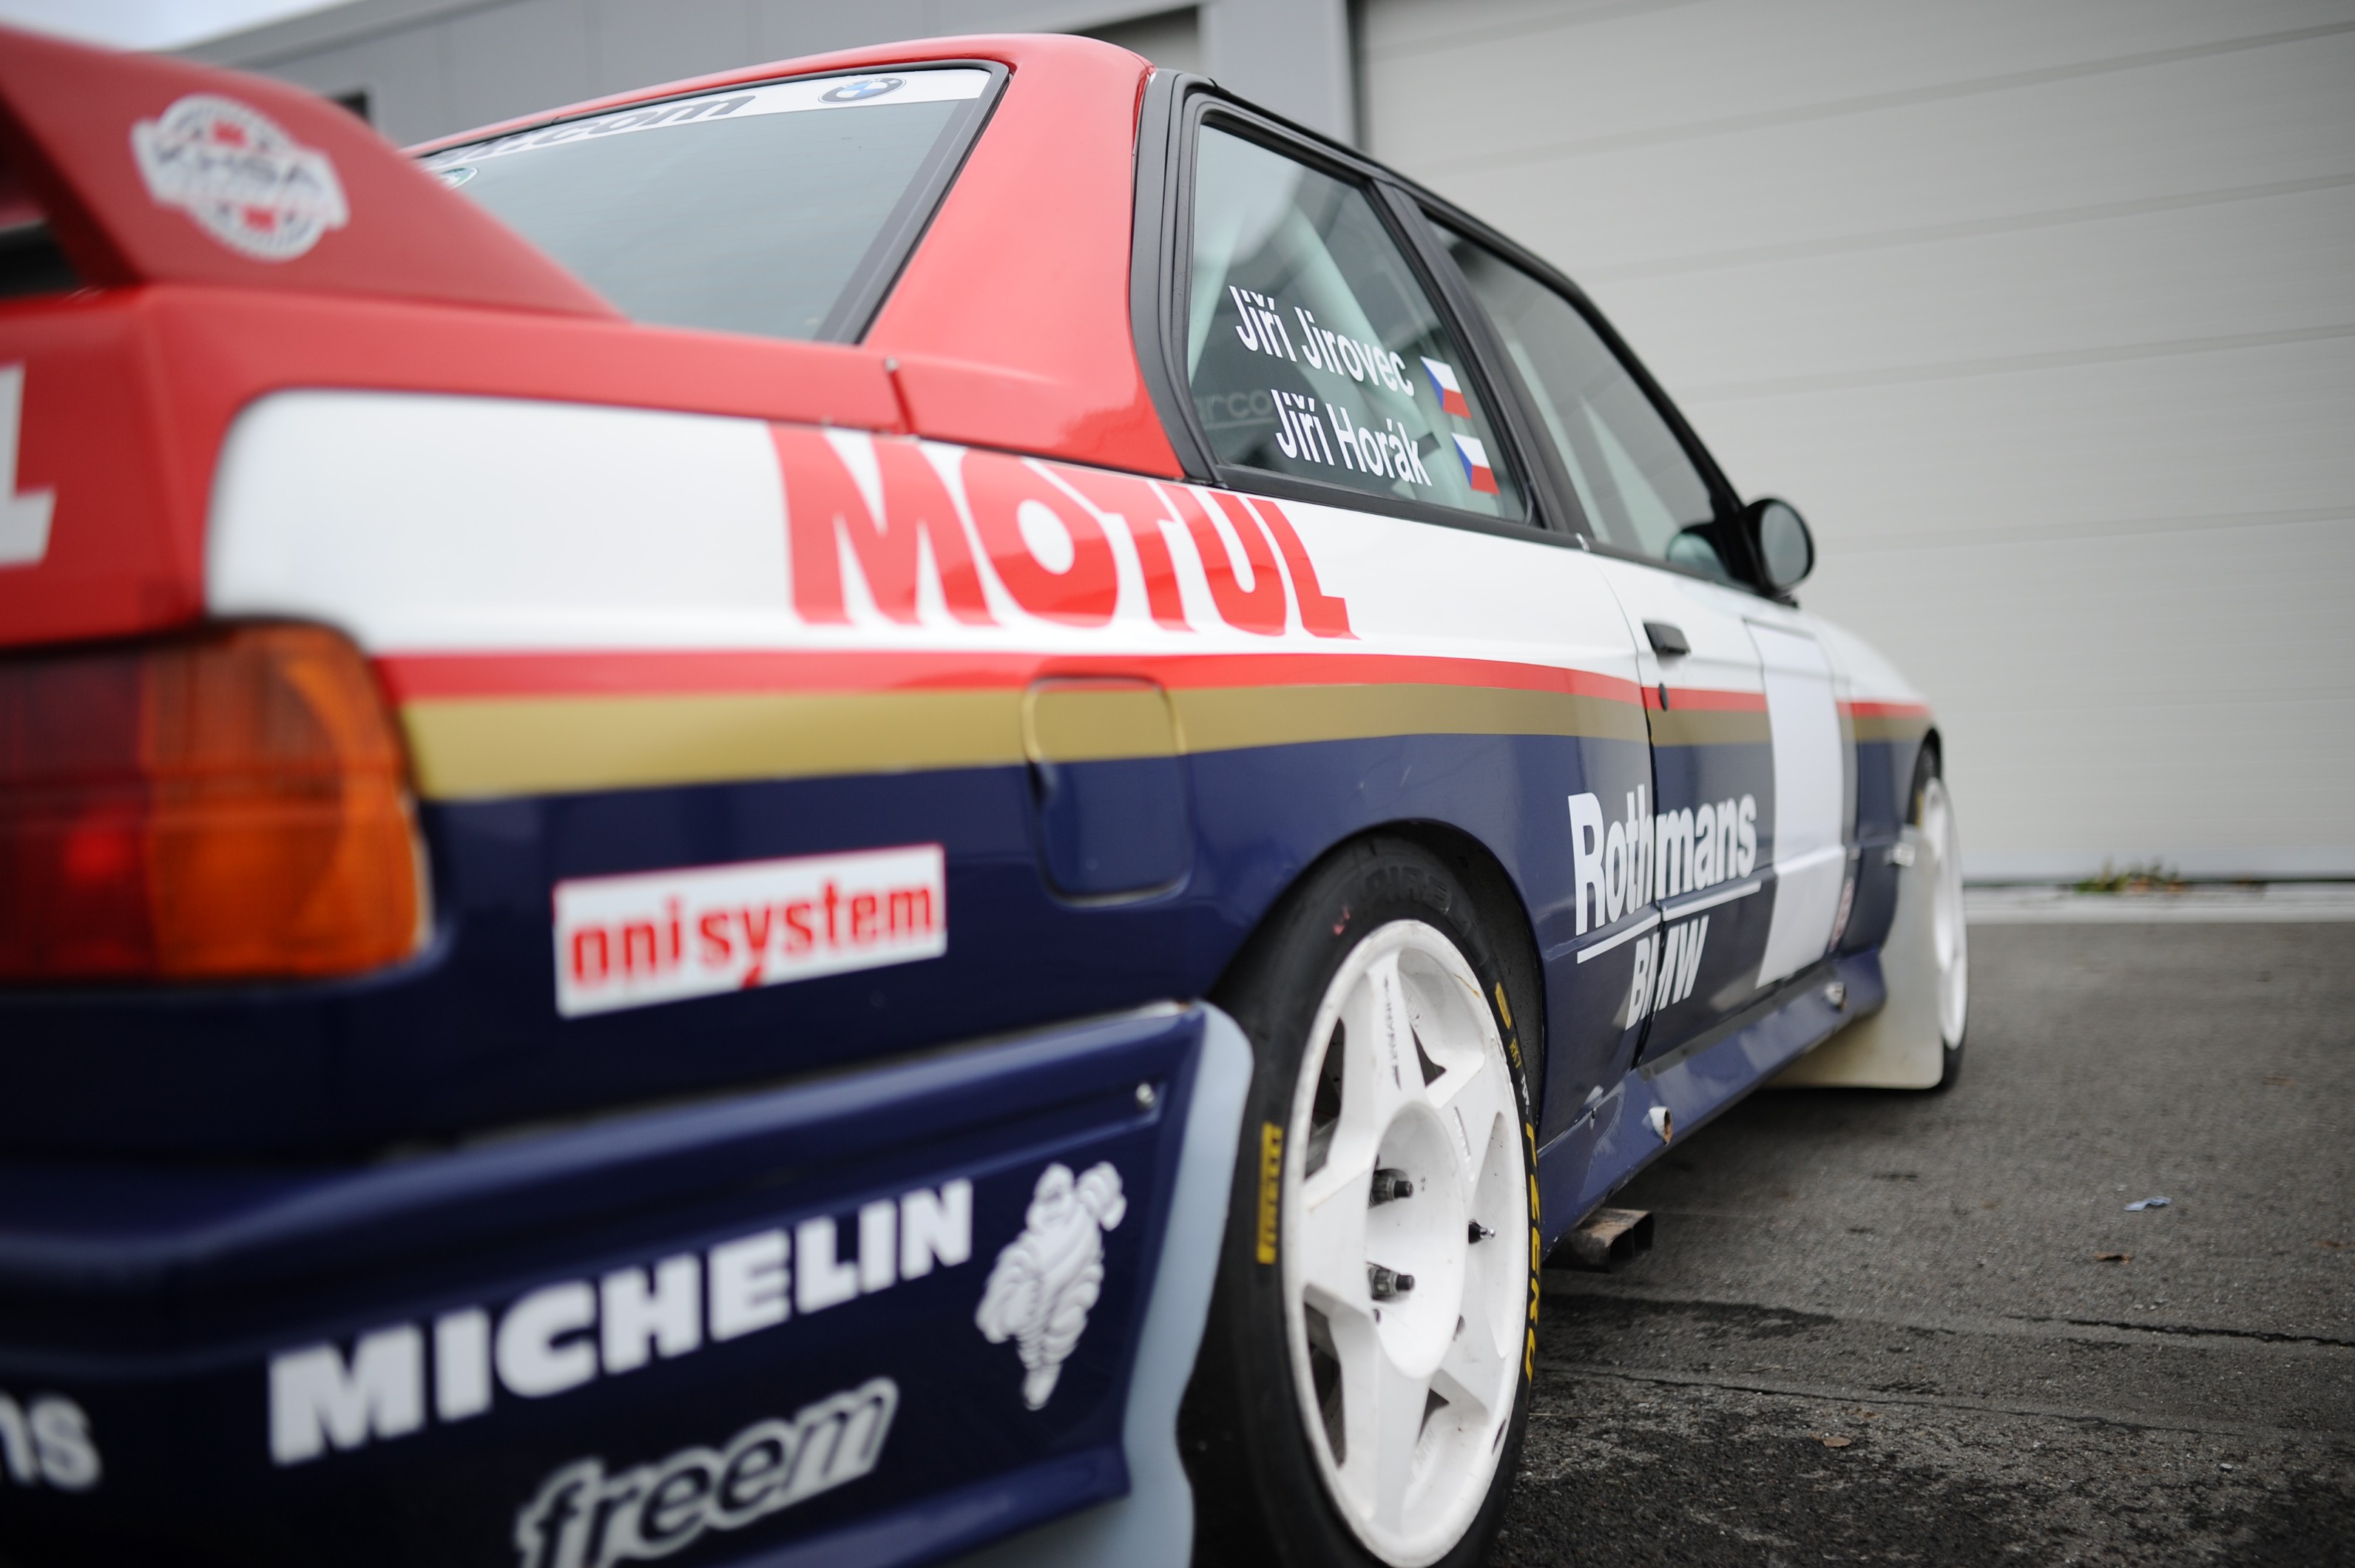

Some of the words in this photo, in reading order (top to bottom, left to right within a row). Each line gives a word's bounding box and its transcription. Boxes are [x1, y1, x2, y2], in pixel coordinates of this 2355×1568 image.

[1229, 285, 1297, 362] Jiří
[1294, 307, 1414, 396] Jirovec
[1271, 389, 1334, 465] Jiří
[1325, 403, 1432, 486] Horák
[766, 422, 1361, 641] MOTUL
[1568, 784, 1757, 936] Rothmans
[1625, 915, 1709, 1030] BMW
[268, 1179, 973, 1465] MICHELIN
[516, 1379, 896, 1568] freem
